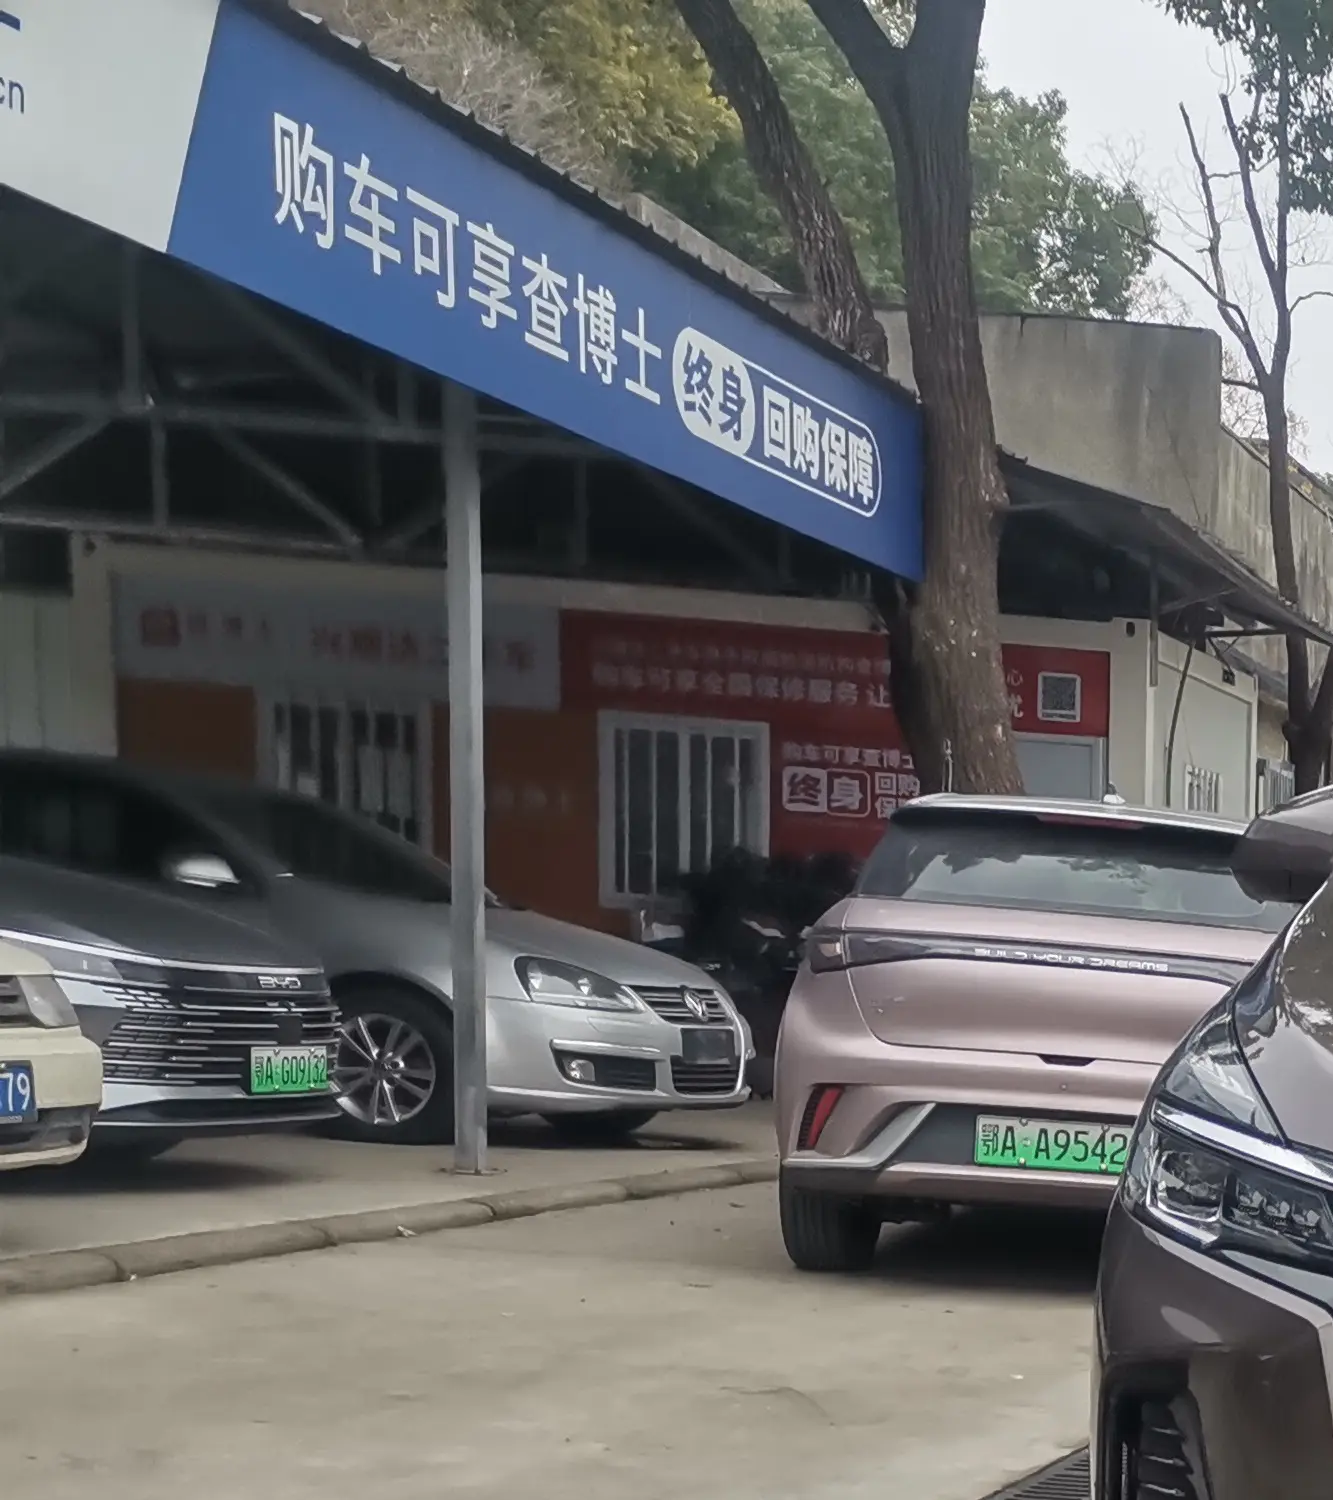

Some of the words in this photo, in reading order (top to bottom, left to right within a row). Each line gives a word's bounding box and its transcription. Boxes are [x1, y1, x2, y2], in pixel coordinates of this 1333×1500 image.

[273, 112, 662, 405] 购车可享查博士
[683, 341, 746, 441] 终身
[763, 385, 874, 505] 回购保障
[786, 771, 864, 811] 终身
[1033, 953, 1085, 965] YOUR
[1089, 957, 1169, 972] DREAMS
[257, 975, 301, 989] BYD
